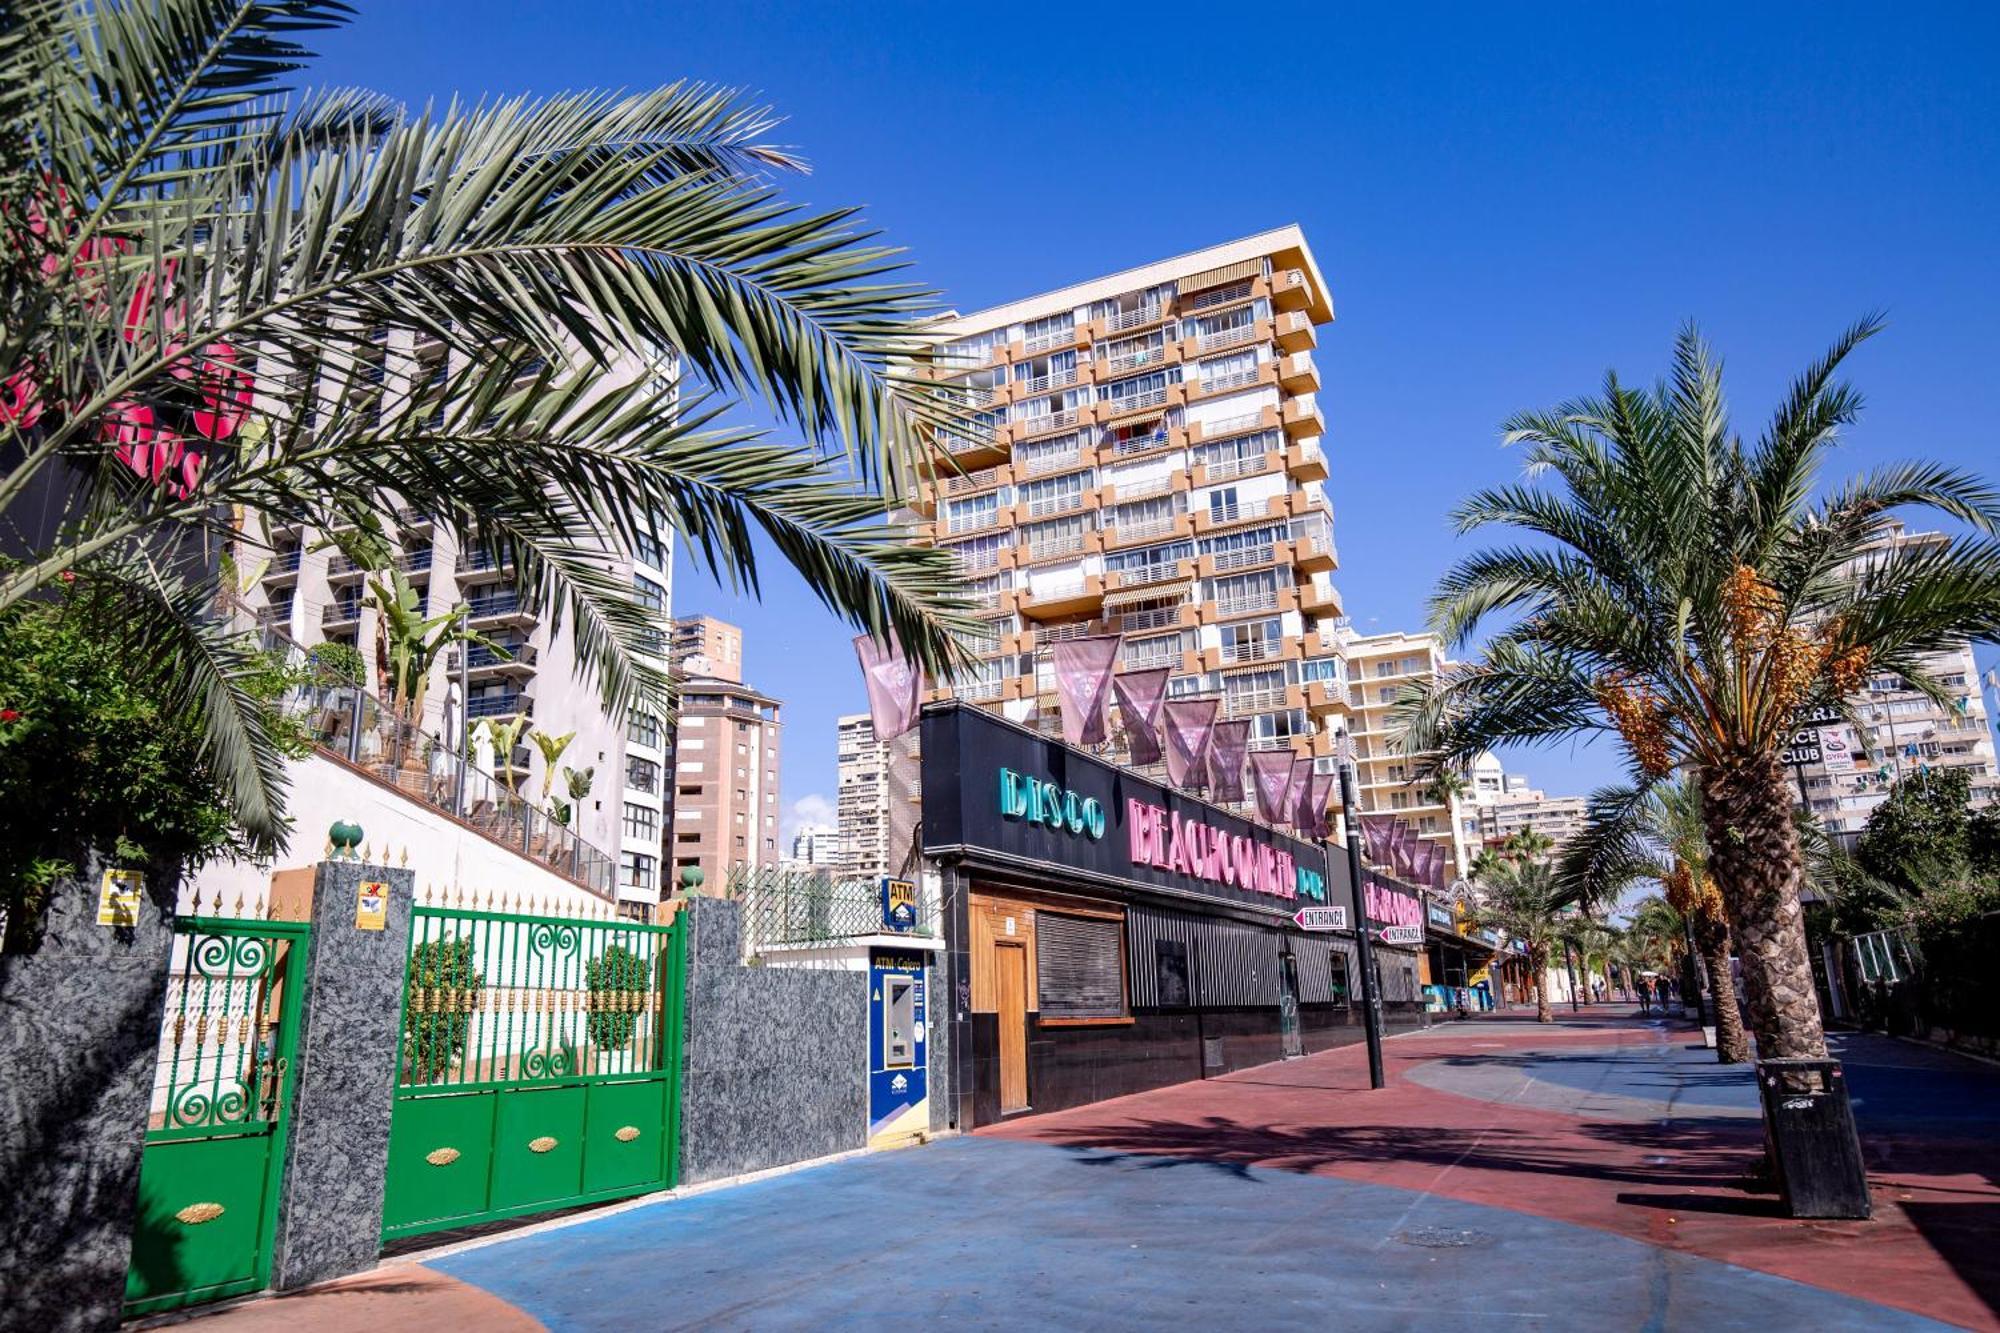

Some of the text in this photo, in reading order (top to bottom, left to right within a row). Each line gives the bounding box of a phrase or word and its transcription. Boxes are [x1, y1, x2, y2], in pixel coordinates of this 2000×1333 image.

[1780, 748, 1820, 764] CLUB
[1000, 767, 1105, 839] DISCO
[1129, 798, 1297, 900] BEACHCOMBER
[891, 883, 913, 902] ATM
[1305, 911, 1344, 926] ENTRANCE
[875, 956, 894, 970] ATM
